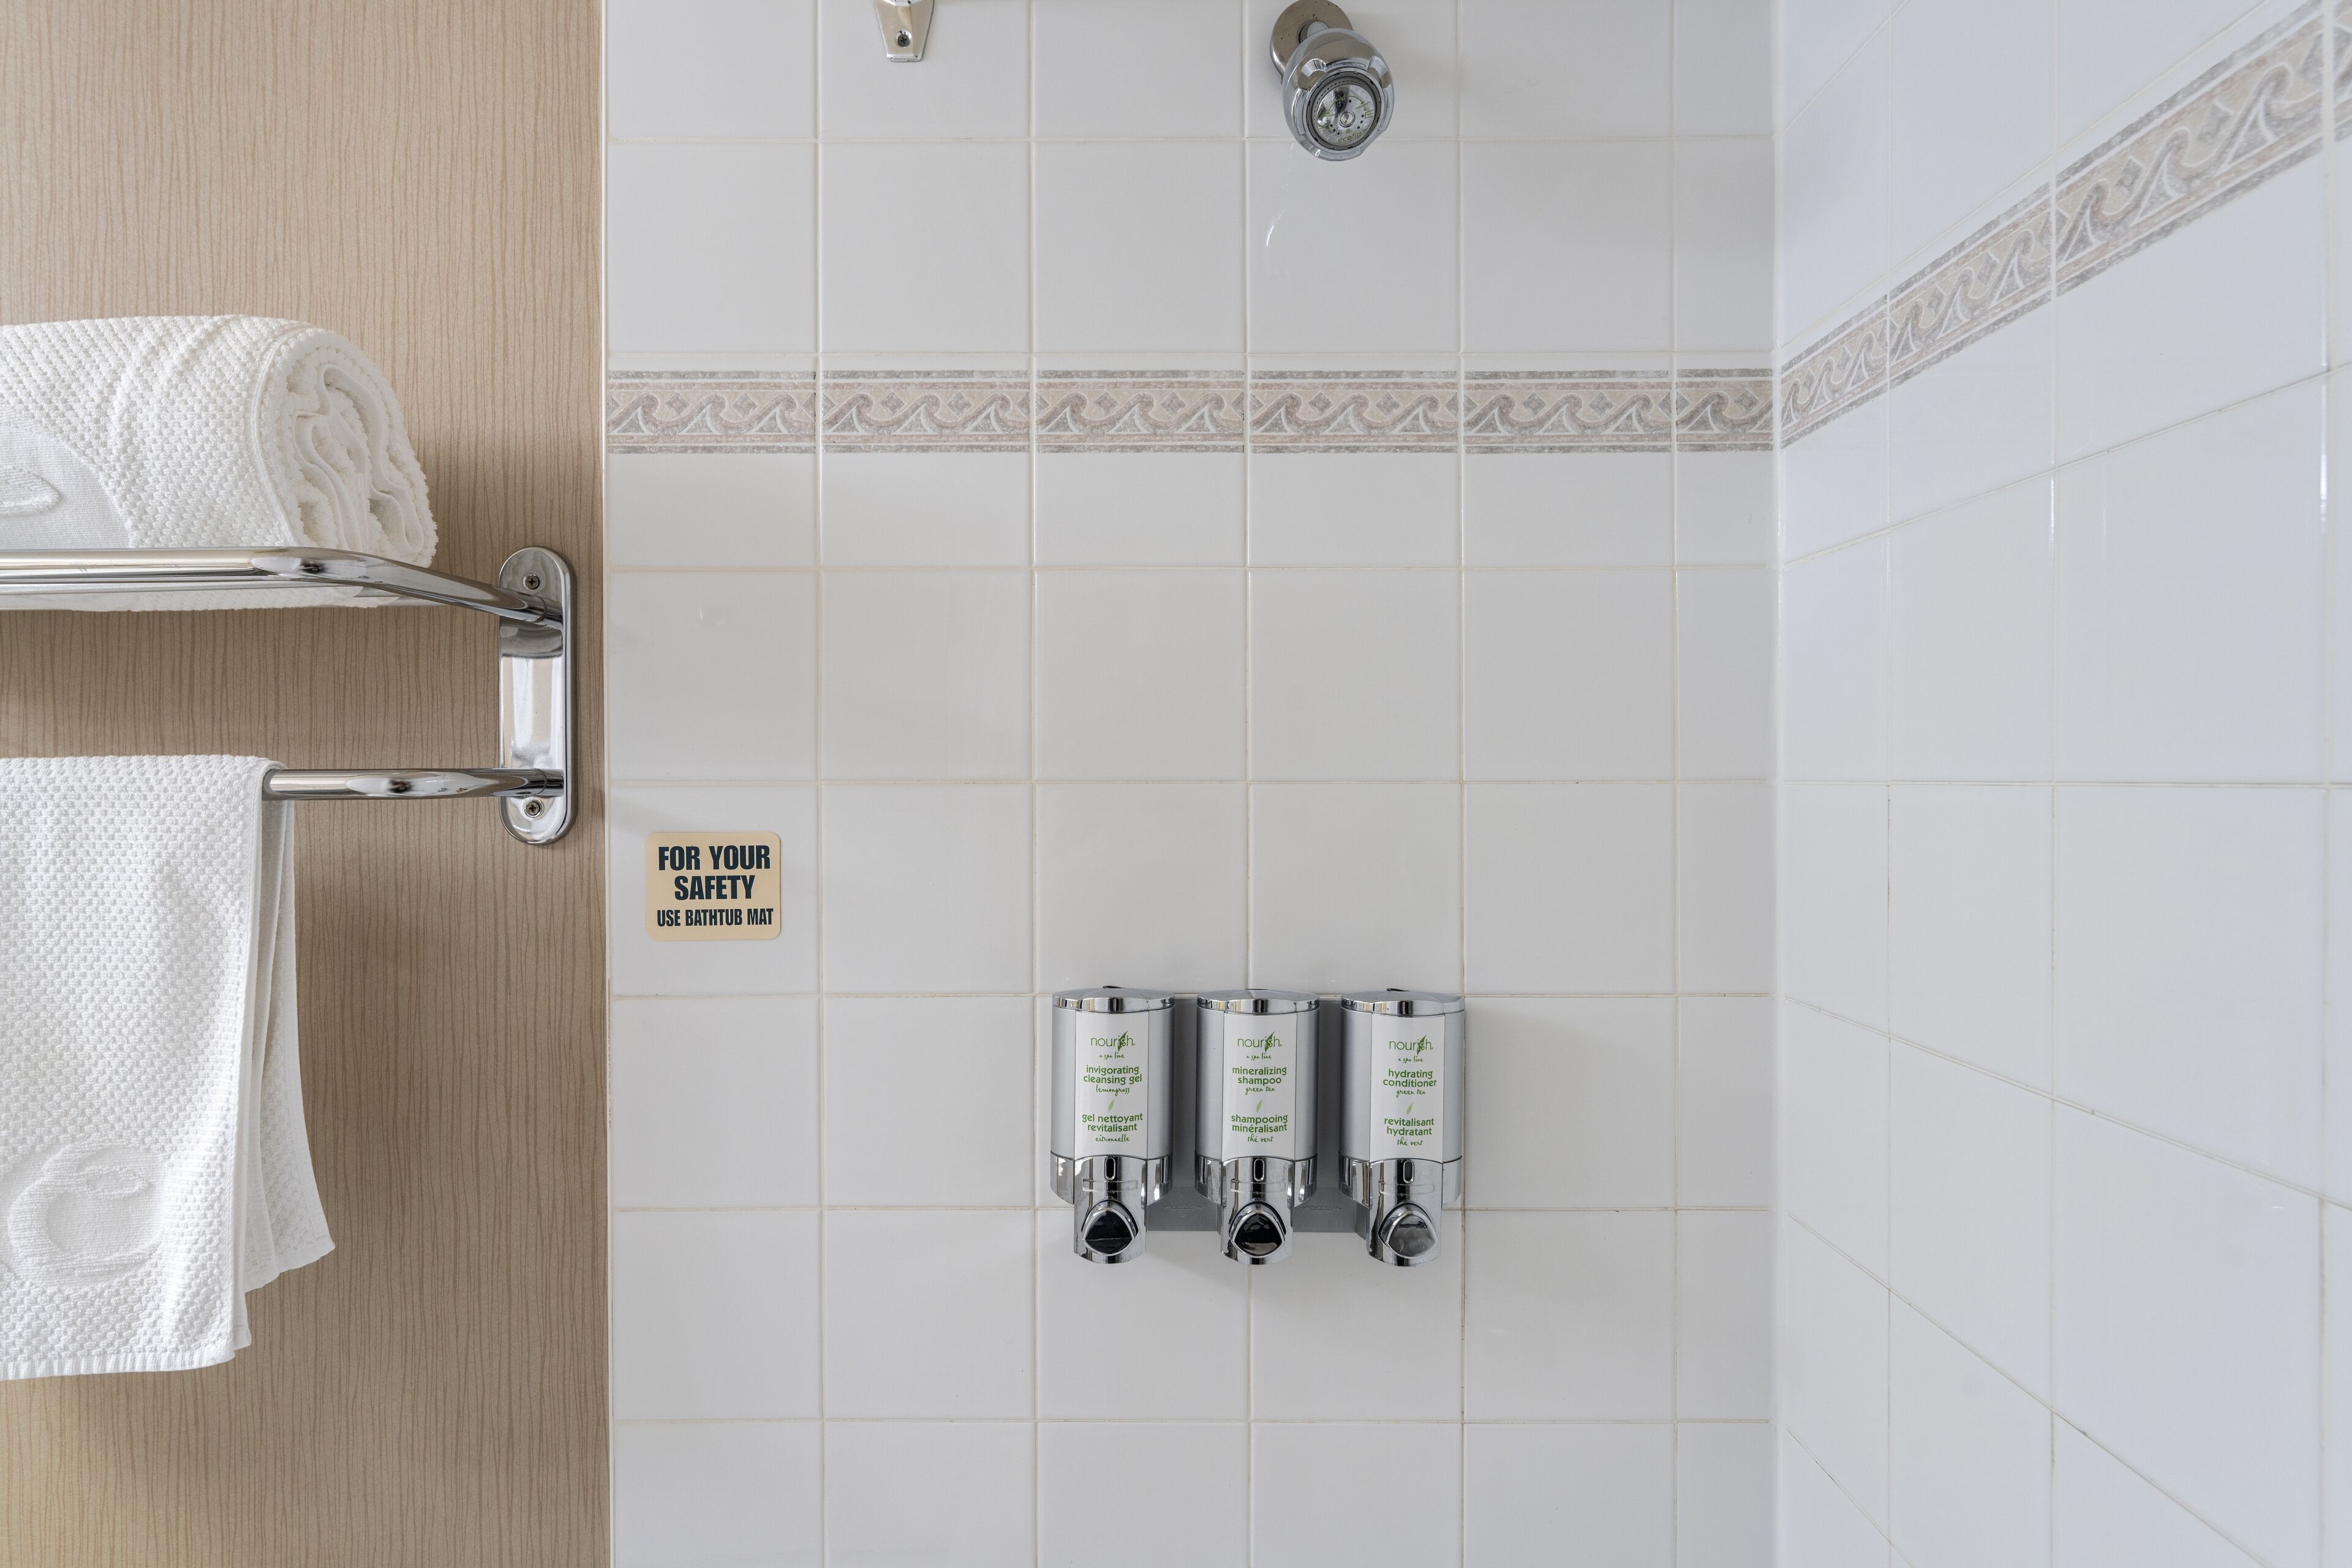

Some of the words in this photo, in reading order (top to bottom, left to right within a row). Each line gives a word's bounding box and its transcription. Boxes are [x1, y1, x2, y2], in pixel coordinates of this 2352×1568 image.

[658, 845, 700, 870] FOR
[709, 845, 770, 870] YOUR
[674, 875, 755, 900] SAFETY
[657, 910, 680, 927] USE
[685, 909, 742, 926] BATHTUB
[747, 908, 773, 925] MAT
[1090, 1033, 1135, 1050] nourish
[1237, 1034, 1281, 1050] nourish
[1389, 1036, 1433, 1053] nourish
[1086, 1065, 1139, 1076] invigorating
[1232, 1066, 1287, 1076] mineralizing
[1388, 1068, 1433, 1079] hydrating
[1083, 1075, 1127, 1086] cleansing
[1129, 1074, 1142, 1085] gel
[1237, 1076, 1282, 1086] shampoo
[1382, 1079, 1436, 1088] conditioner
[1095, 1085, 1130, 1096] lemongrass
[1098, 1114, 1143, 1123] nettoyant
[1231, 1114, 1288, 1125] shampooing
[1384, 1118, 1434, 1127] revitalisant
[1088, 1123, 1137, 1133] revitalisant
[1231, 1123, 1287, 1133] minéralisant
[1387, 1126, 1431, 1136] hydratant
[1095, 1133, 1129, 1142] citronnelle
[1247, 1133, 1258, 1142] thé
[1397, 1137, 1408, 1145] thé
